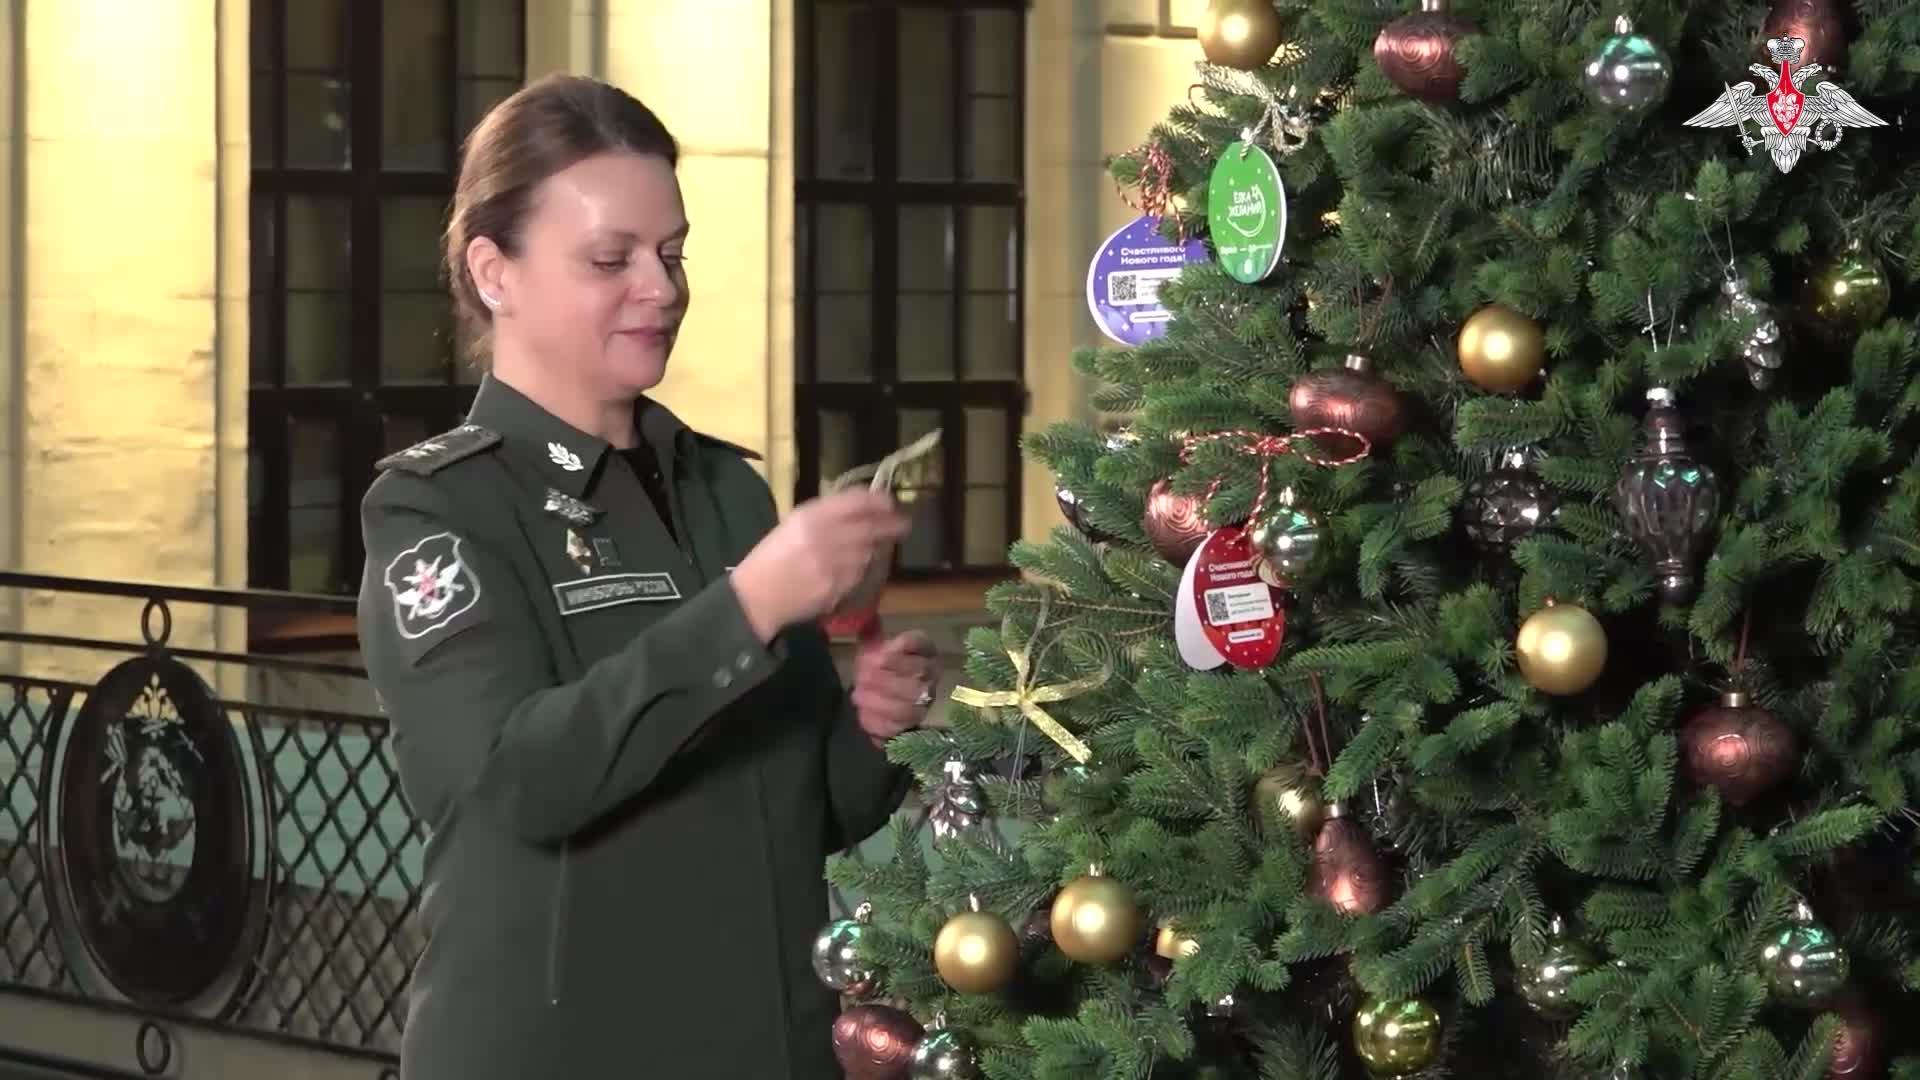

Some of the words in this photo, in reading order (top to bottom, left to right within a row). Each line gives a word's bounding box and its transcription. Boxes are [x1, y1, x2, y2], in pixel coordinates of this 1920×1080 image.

[1120, 247, 1186, 256] Счастливого
[1120, 255, 1158, 265] Нового
[1210, 572, 1237, 582] Нового
